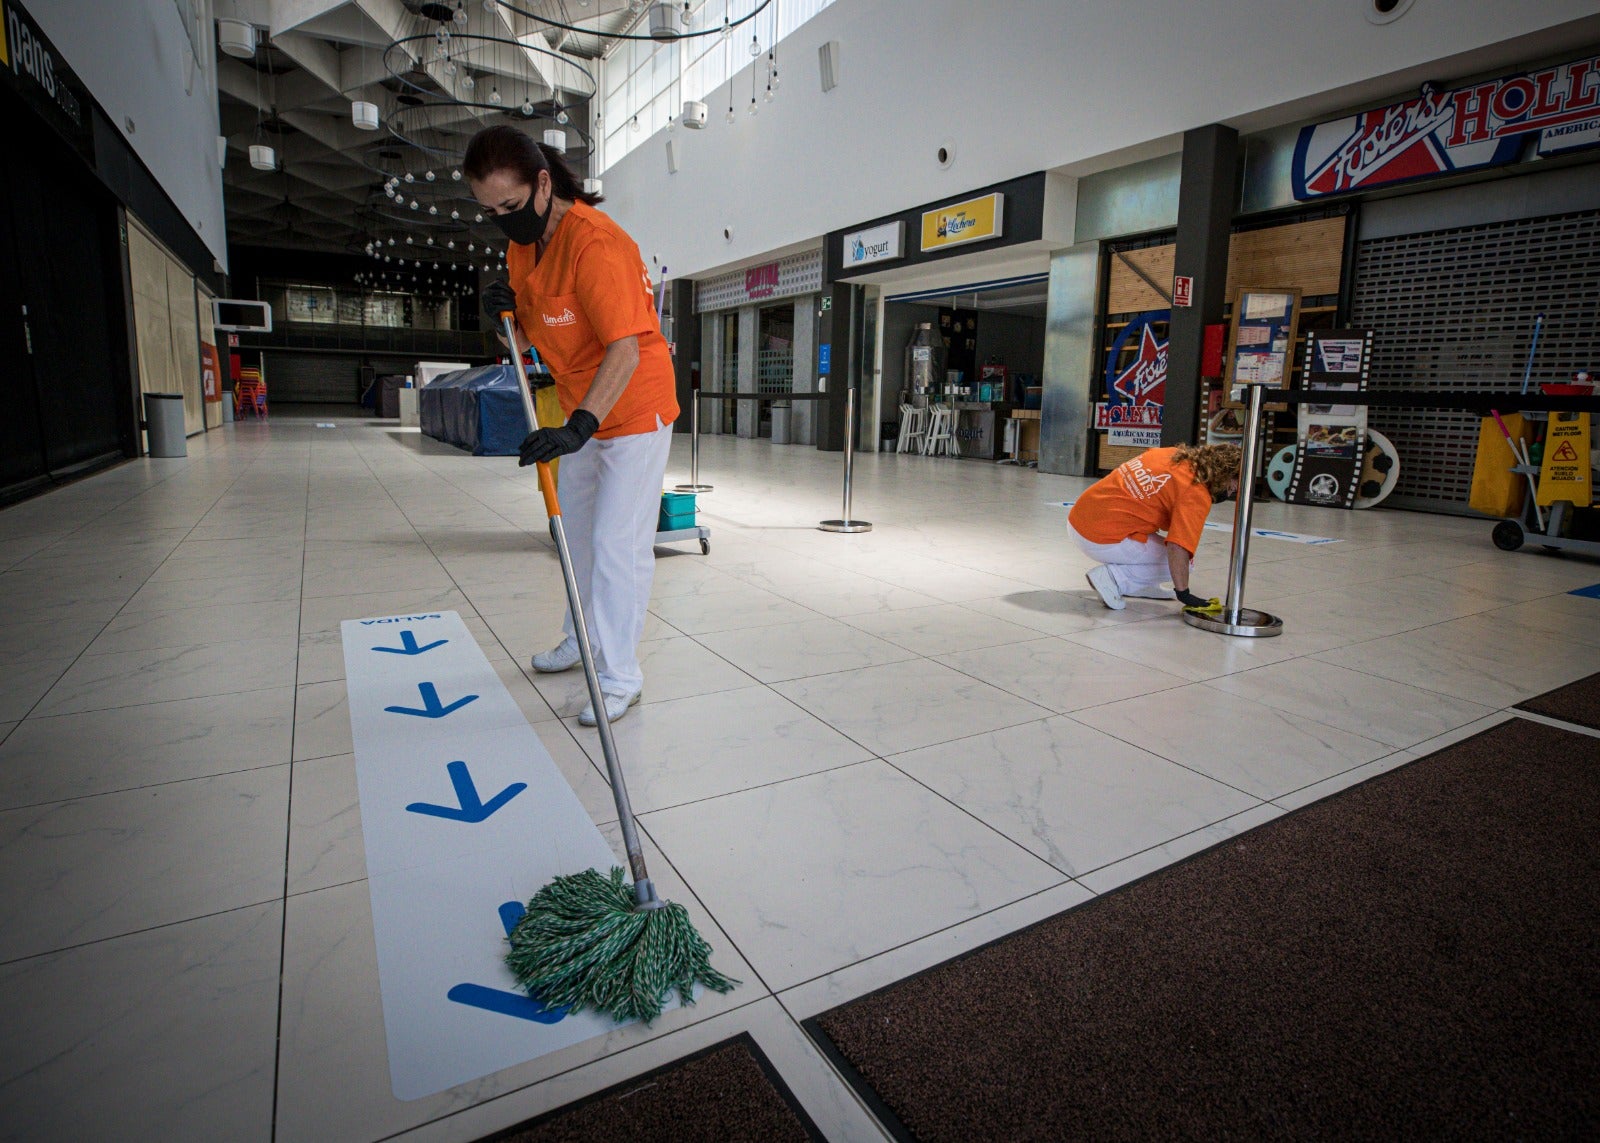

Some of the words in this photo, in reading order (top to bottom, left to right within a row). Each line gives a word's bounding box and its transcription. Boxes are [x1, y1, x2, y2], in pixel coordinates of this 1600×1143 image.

[8, 4, 56, 98] pans
[1447, 56, 1600, 148] HOLL
[1333, 82, 1454, 190] Foster's
[1544, 120, 1600, 139] AMERIC
[864, 241, 889, 260] yogurt
[745, 262, 779, 291] CANTINA
[1112, 429, 1145, 437] AMERICAN
[360, 614, 441, 625] SALIDA
